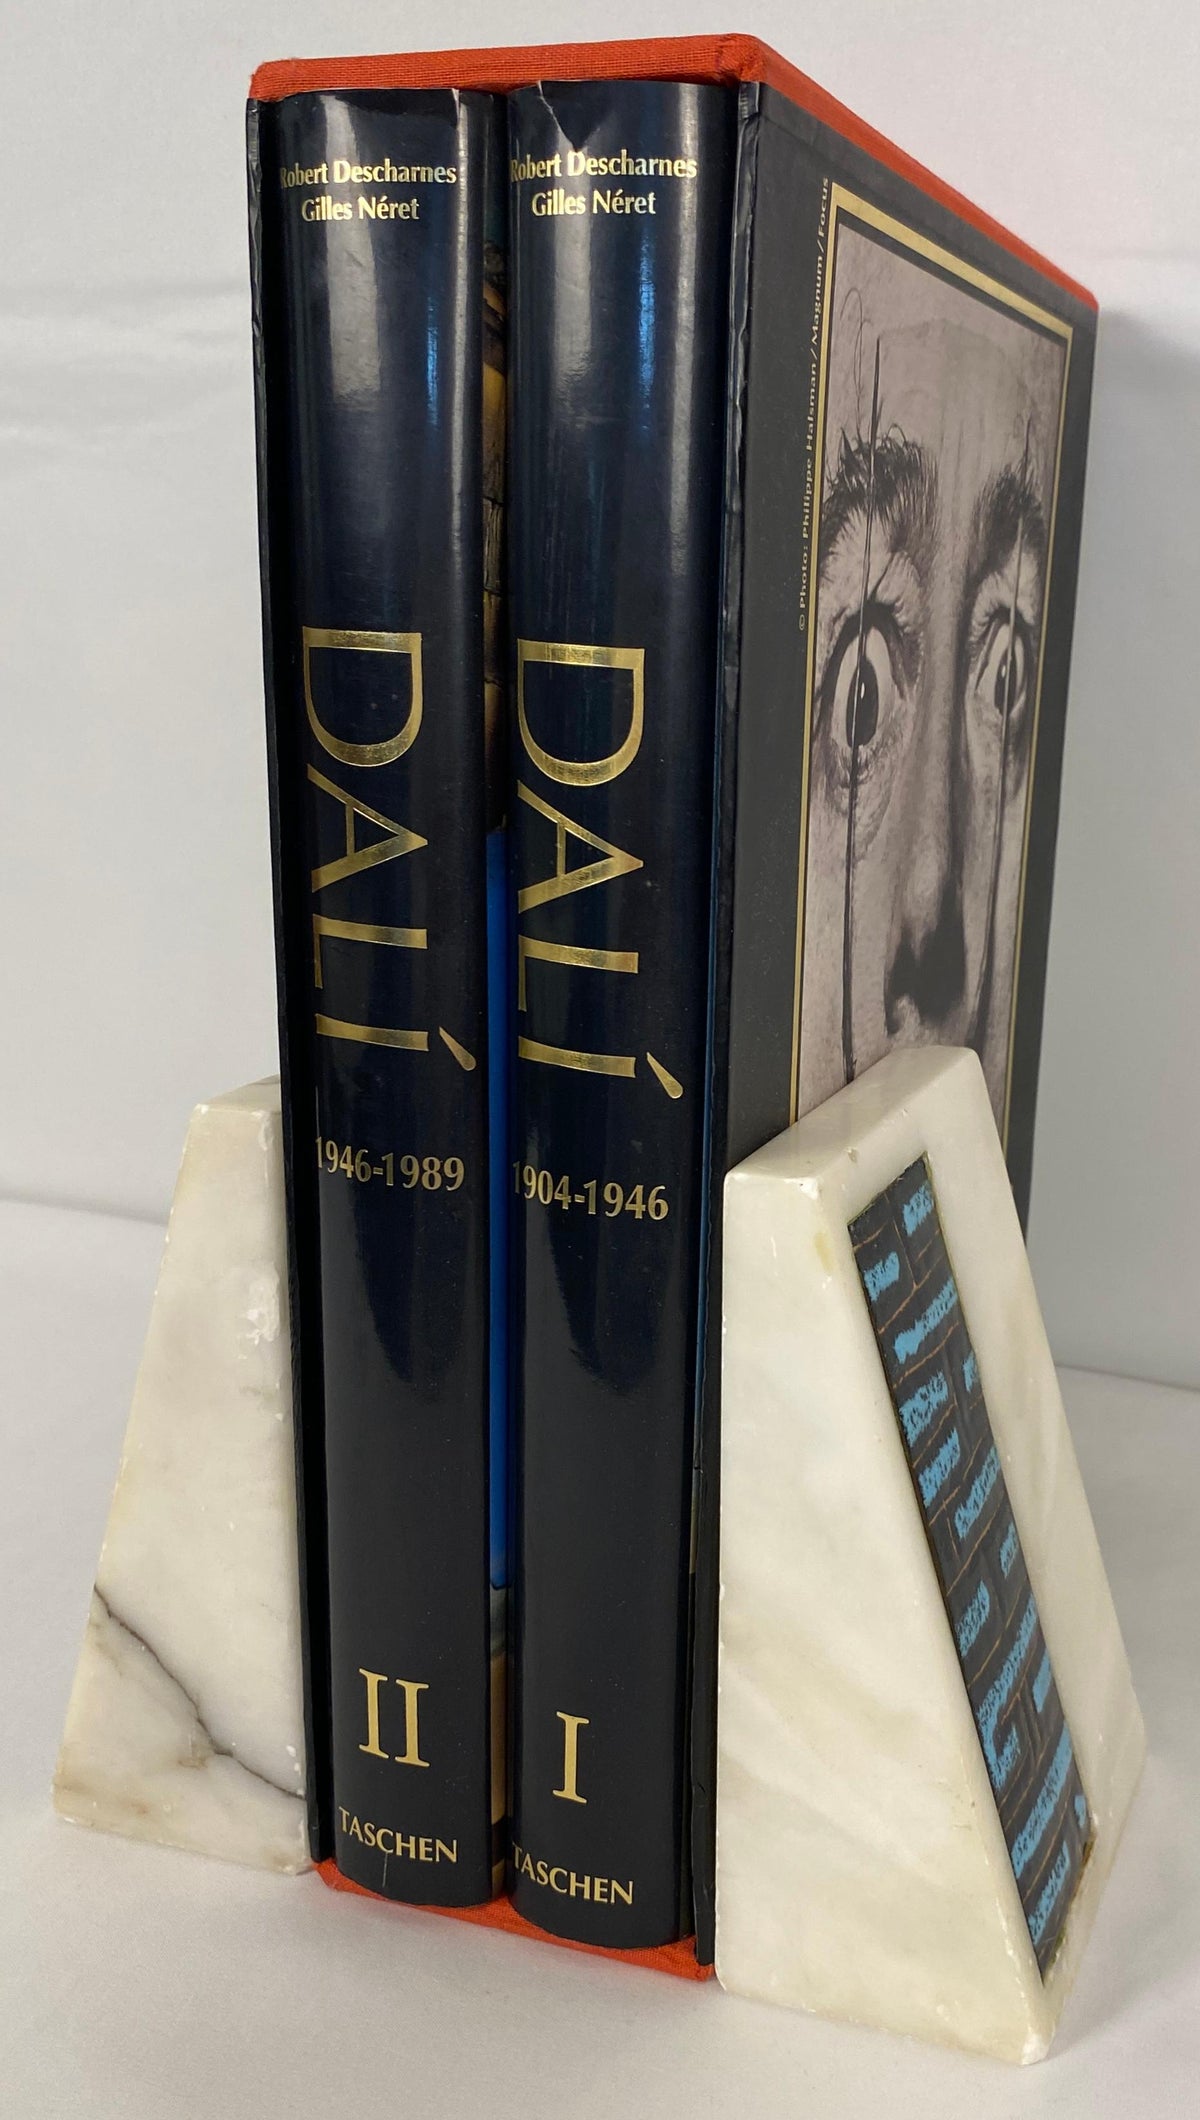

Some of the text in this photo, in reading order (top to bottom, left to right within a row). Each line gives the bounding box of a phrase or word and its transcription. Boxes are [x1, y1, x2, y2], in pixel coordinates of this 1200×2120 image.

[280, 157, 458, 188] Robert Descharnes
[510, 148, 698, 182] Robert Descharnes
[301, 195, 420, 222] Gilles Néret
[532, 188, 657, 216] Gilles Néret
[802, 457, 814, 539] Philippe
[302, 625, 477, 1071] DALÍ
[517, 638, 684, 1099] DALÍ
[315, 1135, 466, 1192] 1946-1989
[512, 1160, 670, 1221] 1904-1946
[358, 1667, 430, 1768] II
[552, 1710, 590, 1804] I
[338, 1806, 458, 1864] TASCHEN
[512, 1840, 634, 1905] TASCHEN
